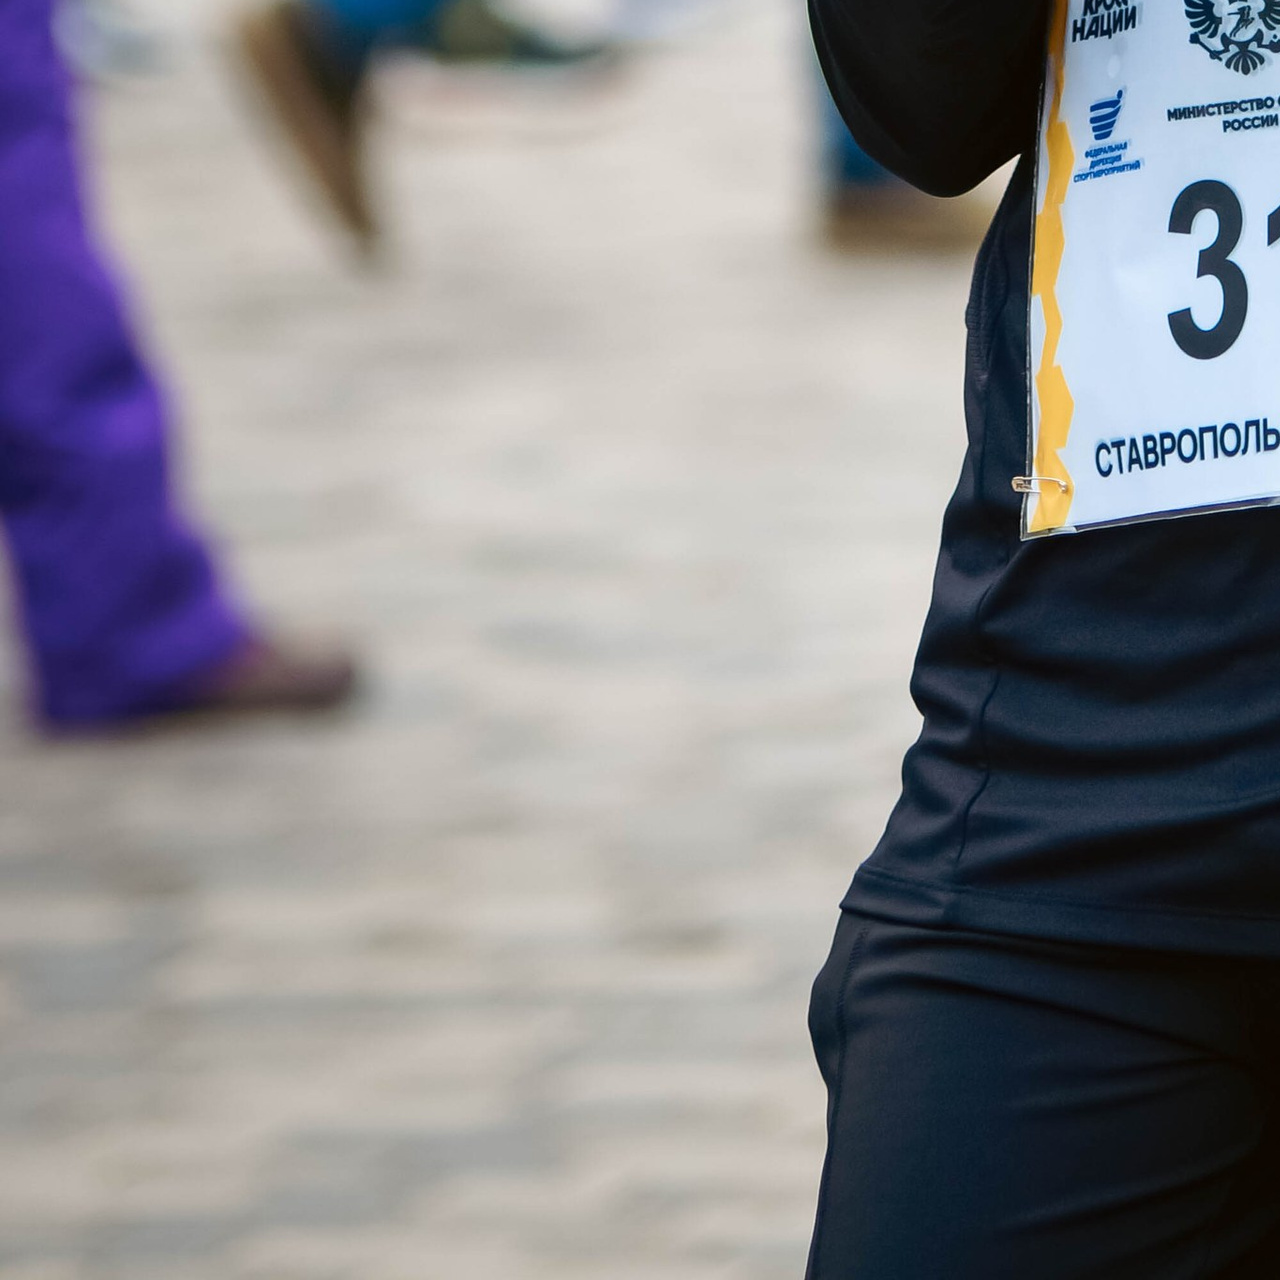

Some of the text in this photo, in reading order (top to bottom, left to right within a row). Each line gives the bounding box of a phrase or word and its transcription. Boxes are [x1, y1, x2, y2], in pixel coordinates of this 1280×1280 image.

[1072, 5, 1137, 43] НАЦИИ
[1166, 96, 1276, 122] МИНИСТЕРСТВО
[1222, 113, 1280, 133] РОССИИ
